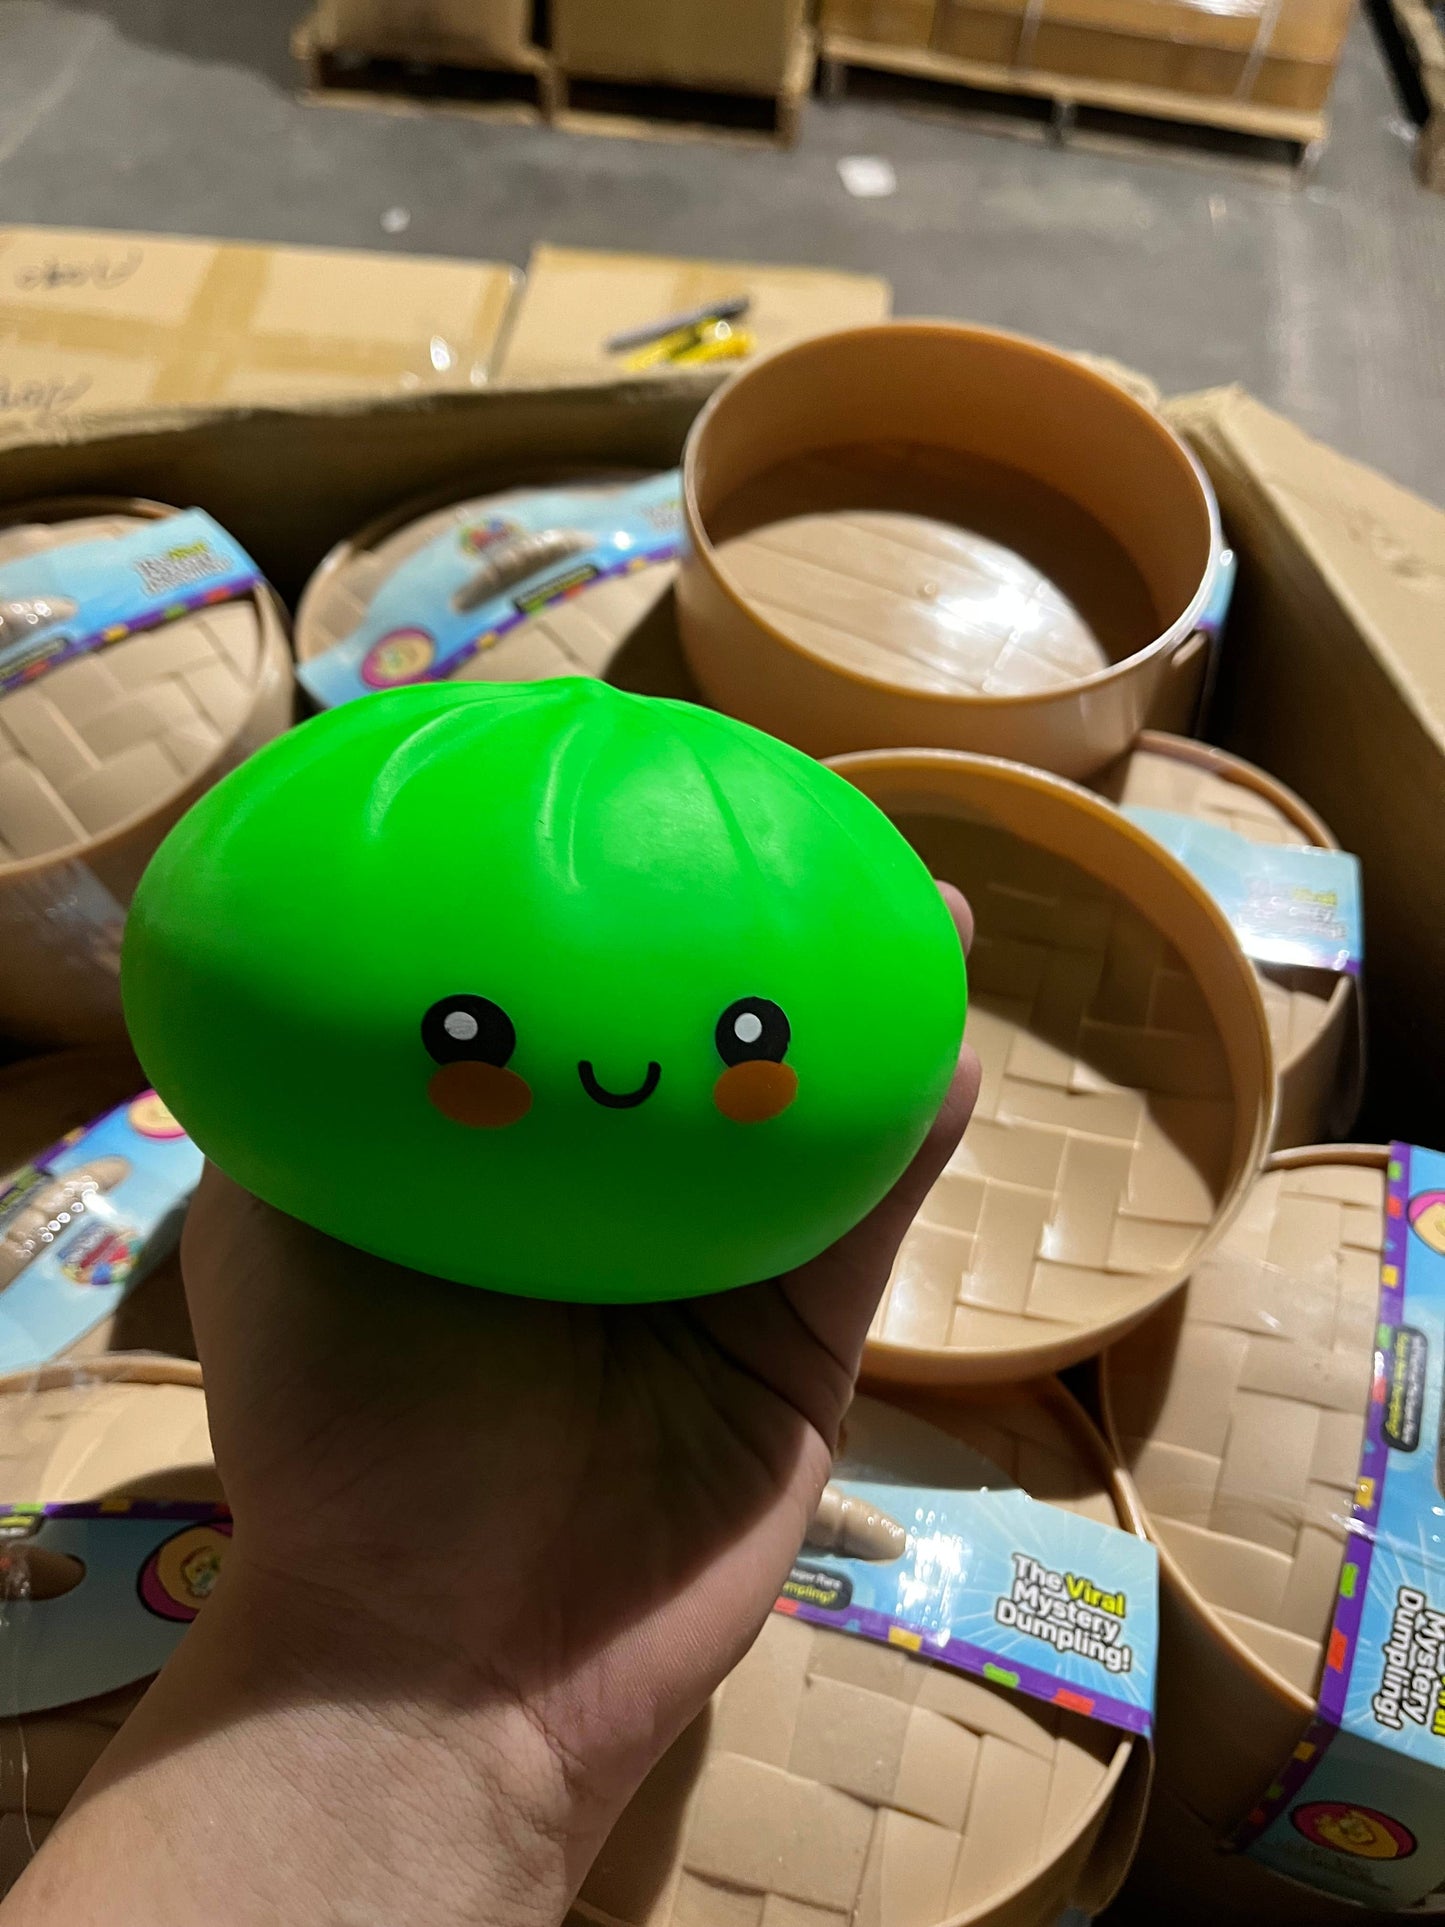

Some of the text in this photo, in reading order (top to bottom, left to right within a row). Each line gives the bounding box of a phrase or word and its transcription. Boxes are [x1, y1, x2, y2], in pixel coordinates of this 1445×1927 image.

[1012, 1578, 1121, 1644] Mystery
[1013, 1553, 1126, 1619] The Viral
[995, 1597, 1133, 1674] Dumpling!
[1373, 1585, 1427, 1730] Dumpling!
[1401, 1609, 1445, 1725] Mystery
